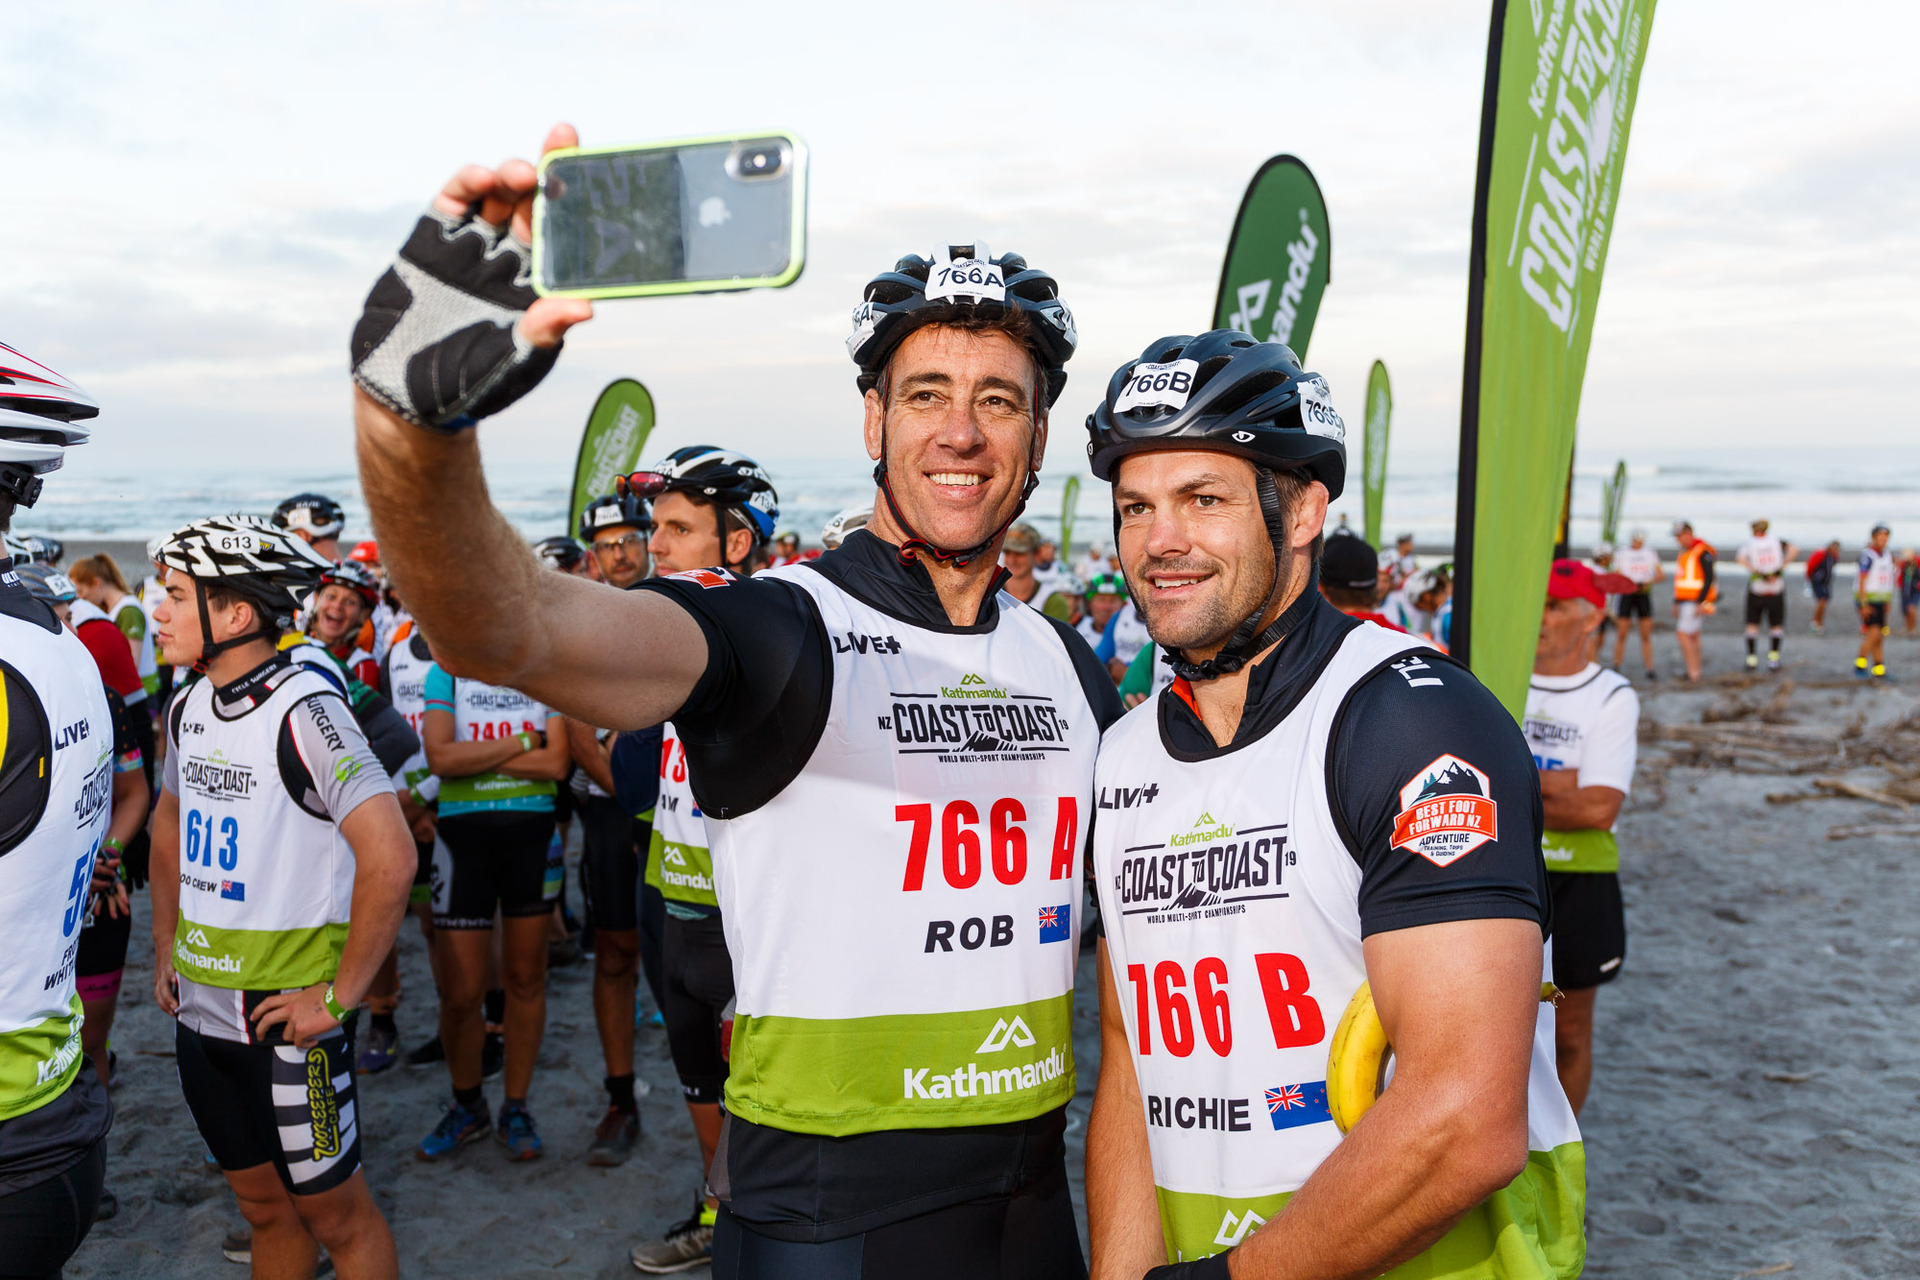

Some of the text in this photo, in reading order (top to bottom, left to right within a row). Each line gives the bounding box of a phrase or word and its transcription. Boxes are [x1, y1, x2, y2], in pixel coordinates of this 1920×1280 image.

[1520, 75, 1589, 332] COAST
[938, 267, 1004, 288] 766A
[1126, 370, 1192, 397] 766B
[221, 535, 252, 550] 613
[833, 631, 902, 654] LIVE+
[231, 663, 278, 694] CYCLE SURGERY
[940, 686, 1007, 700] Kathmandu
[877, 702, 1070, 744] NZ COAST TO COAST 19
[938, 752, 1046, 763] WORLD MULTI-SPORT CHAMPIONSHIPS
[1408, 813, 1482, 836] FORWARD NZ
[1415, 800, 1477, 821] BEST FOOT
[186, 808, 239, 872] 613
[894, 796, 1078, 893] 766 A
[1418, 833, 1471, 847] ADVENTURE
[1121, 850, 1190, 904] COAST
[1191, 860, 1205, 884] TO
[1207, 836, 1288, 893] COAST
[1284, 850, 1297, 867] 19
[924, 914, 1014, 954] ROB
[1147, 913, 1166, 924] WORLD
[1127, 952, 1326, 1059] 766 B
[903, 1046, 1066, 1100] Kathmandu
[307, 1047, 333, 1161] ZOOKEEPERS
[325, 1087, 339, 1125] CAFE
[1147, 1094, 1252, 1133] RICHIE
